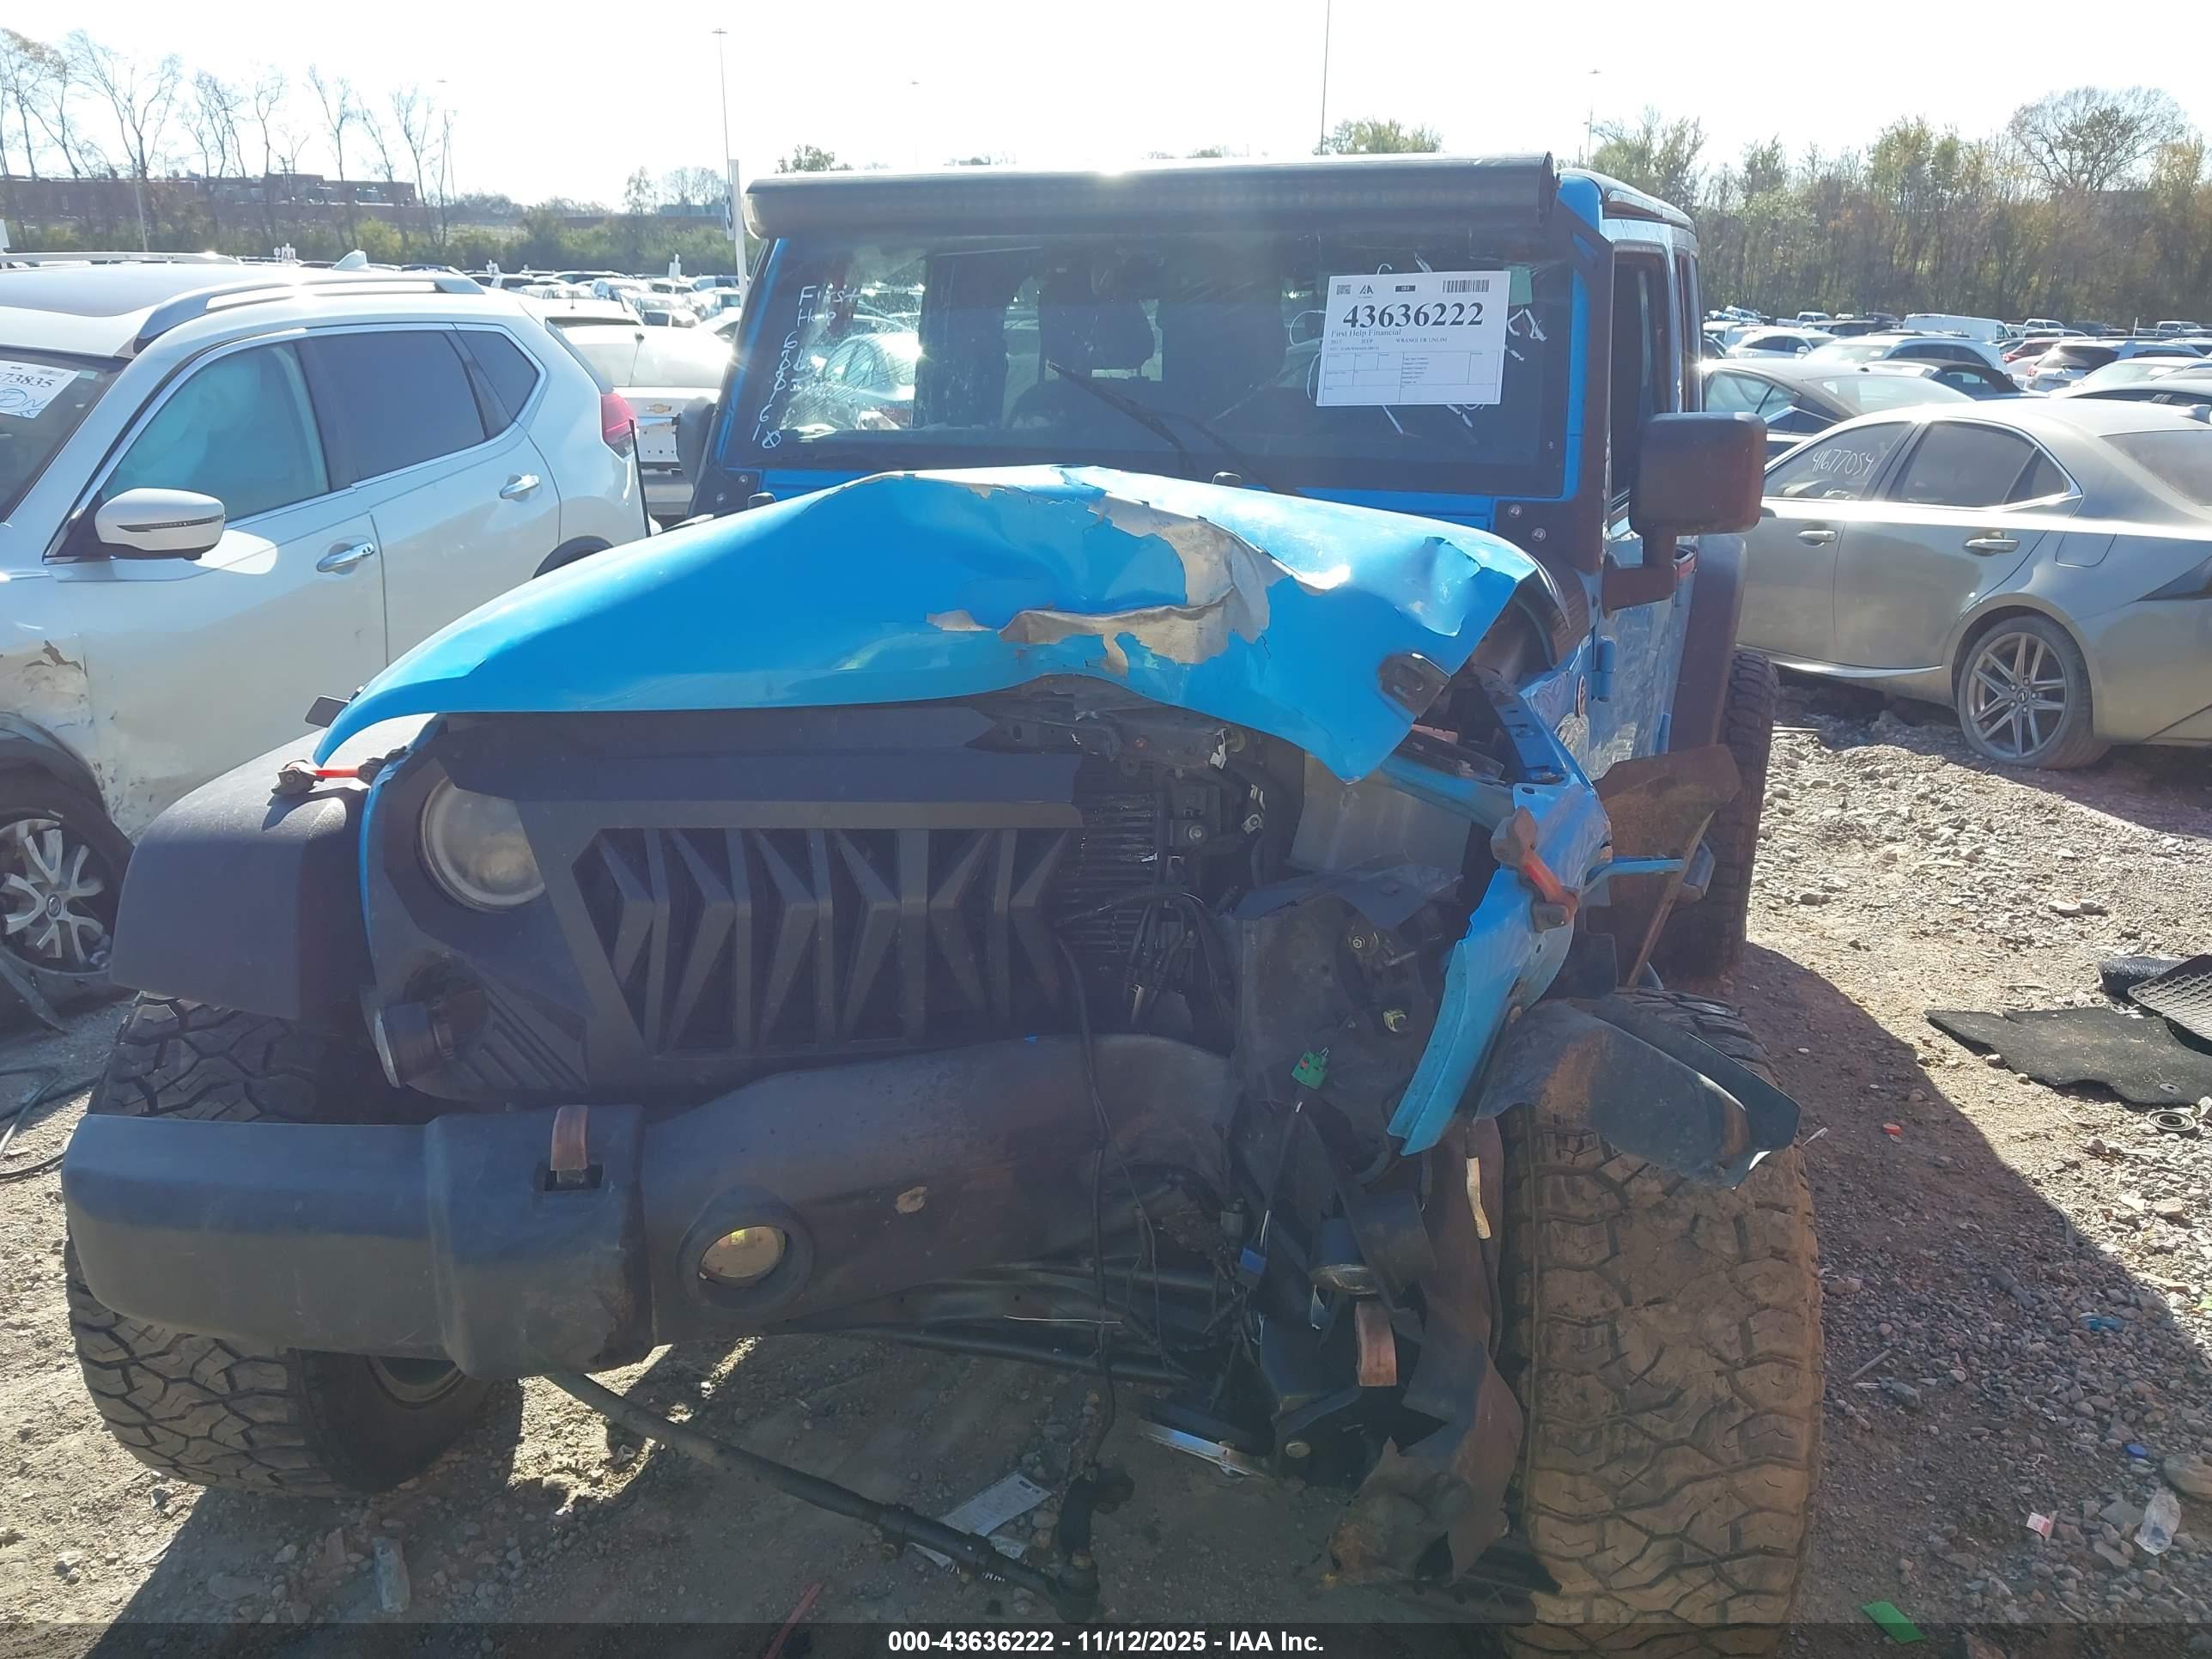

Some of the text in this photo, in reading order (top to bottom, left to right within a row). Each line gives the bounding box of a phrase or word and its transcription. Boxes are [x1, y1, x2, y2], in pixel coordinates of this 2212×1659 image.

[1343, 301, 1484, 328] 43636222
[1349, 329, 1367, 338] Help
[1812, 449, 1875, 477] 41677054
